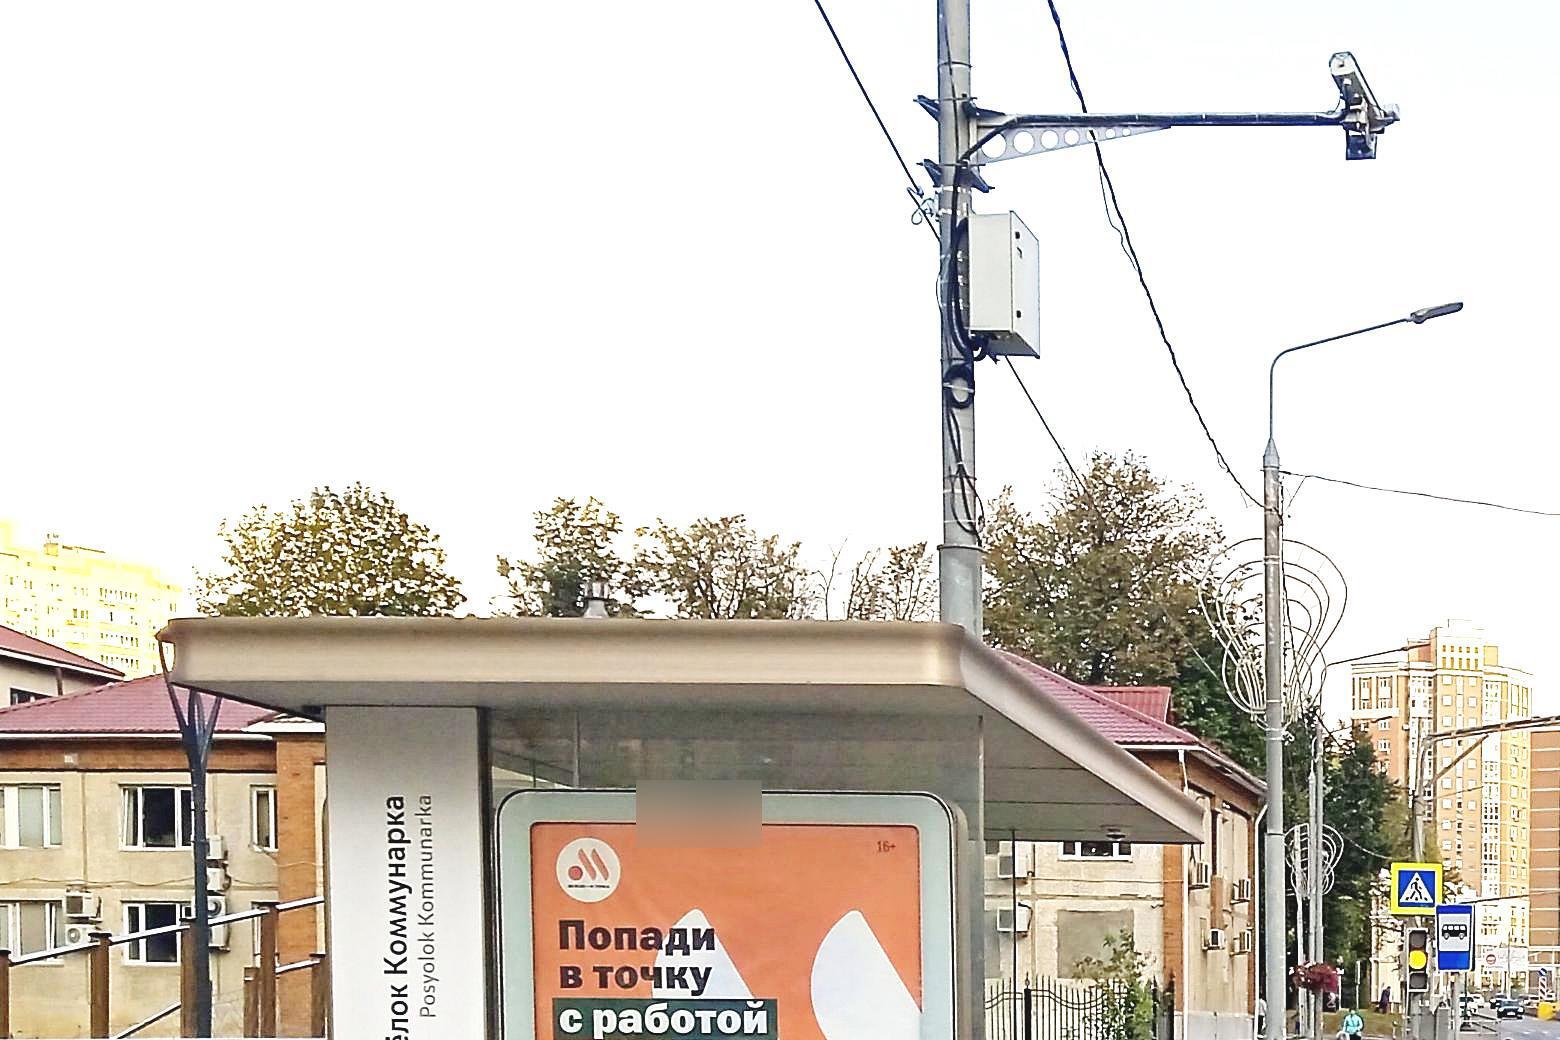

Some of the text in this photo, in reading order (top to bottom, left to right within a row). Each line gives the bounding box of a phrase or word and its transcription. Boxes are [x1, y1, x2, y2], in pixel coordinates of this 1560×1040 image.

[876, 840, 897, 853] 16+
[383, 795, 413, 975] Коммунарка
[414, 794, 440, 1018] Posyolok Kommunarka
[558, 919, 716, 957] Попади
[559, 966, 713, 997] в точку
[559, 1000, 769, 1040] с работой
